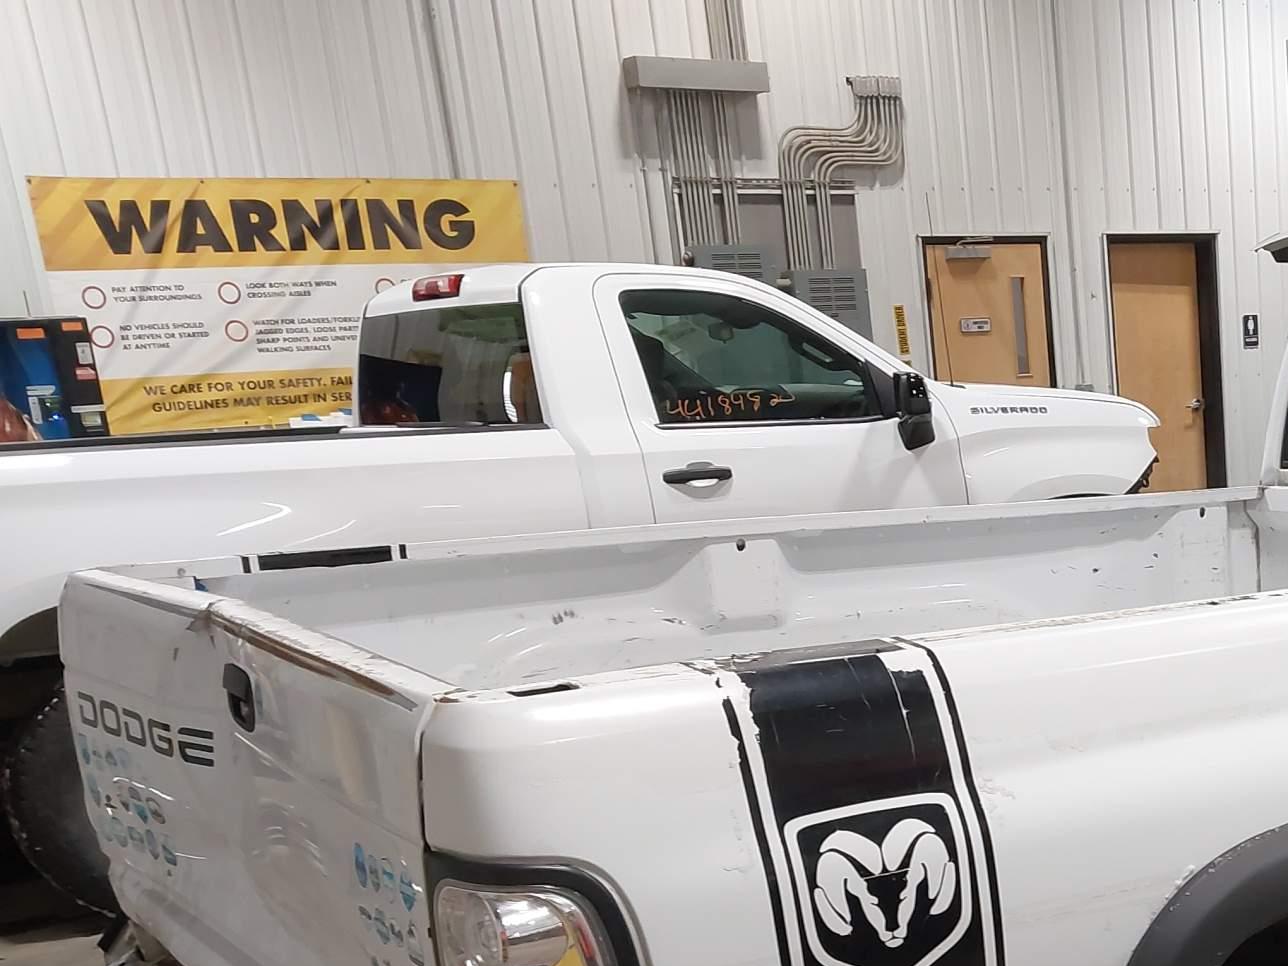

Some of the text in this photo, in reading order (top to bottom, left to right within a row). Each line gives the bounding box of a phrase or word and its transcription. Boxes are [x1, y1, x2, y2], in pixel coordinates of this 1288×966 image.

[84, 198, 475, 255] WARNING
[174, 284, 184, 292] TO
[138, 294, 202, 302] SURROUNDINGS
[134, 342, 170, 350] ANYTIME
[296, 344, 332, 352] SURFACES
[144, 384, 166, 396] WE
[170, 382, 203, 394] CARE
[208, 381, 234, 393] FOR
[238, 379, 275, 391] YOUR
[279, 376, 326, 389] SAFETY.
[151, 391, 352, 413] GUIDELINES MAY RESULT IN SER
[970, 406, 1048, 414] SILVERADO
[78, 691, 215, 767] DODGE
